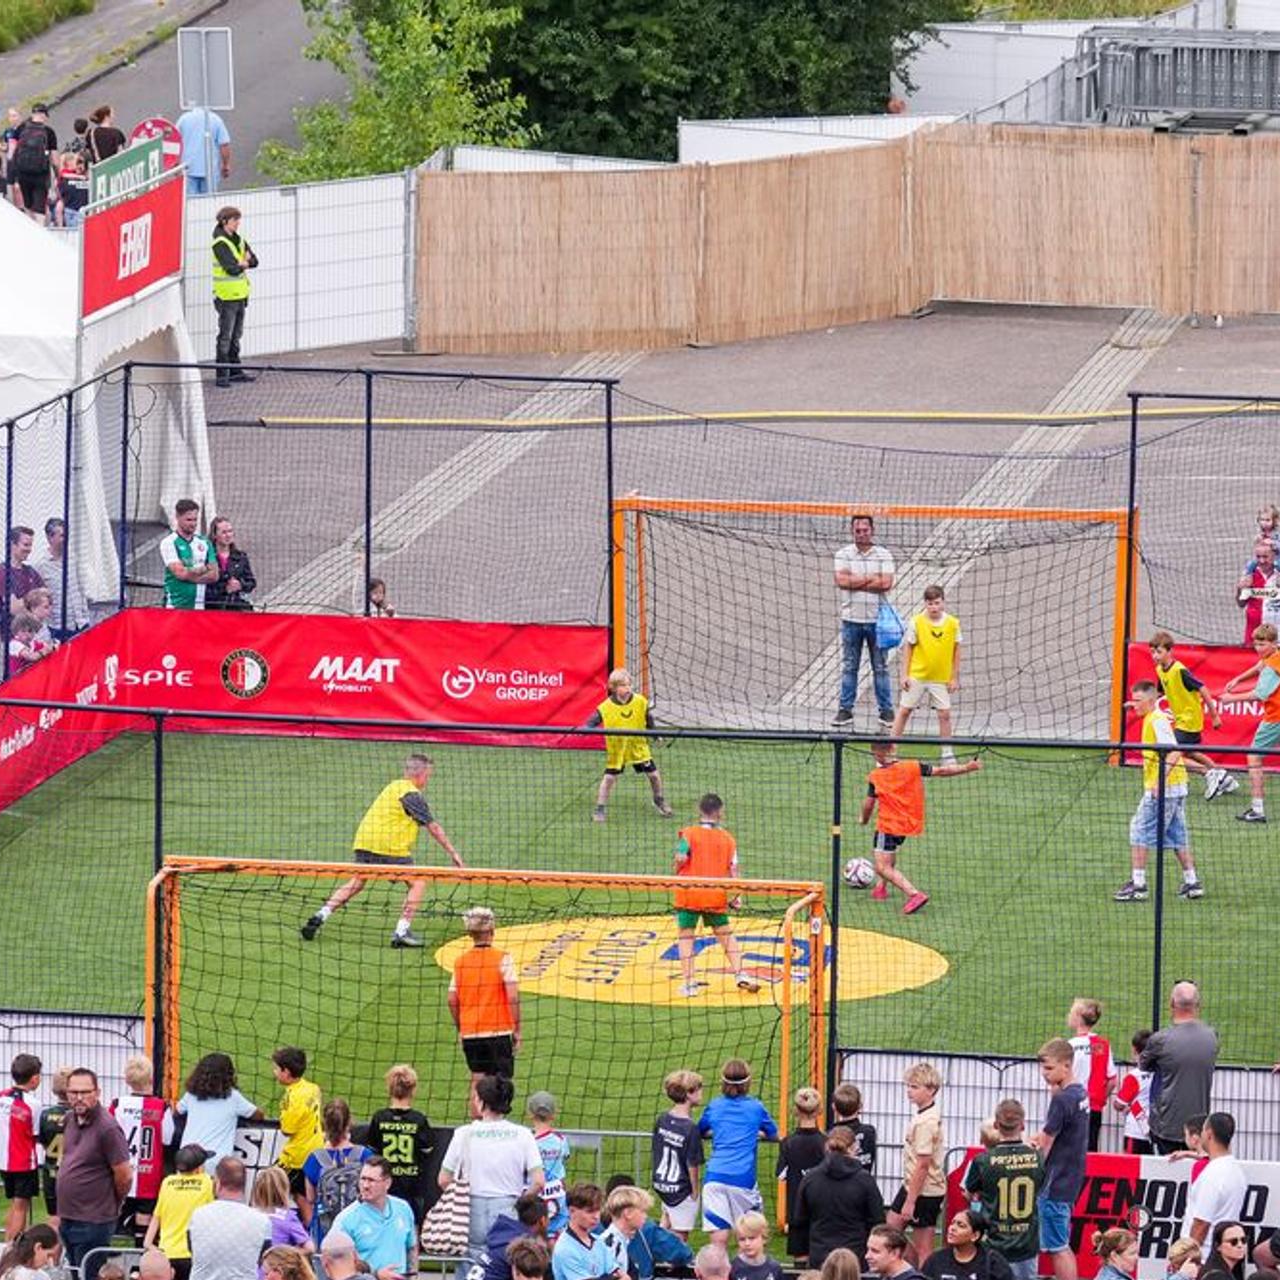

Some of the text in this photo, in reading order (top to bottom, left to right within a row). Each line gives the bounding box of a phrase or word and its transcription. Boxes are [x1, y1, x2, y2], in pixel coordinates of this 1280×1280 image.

[310, 657, 400, 686] MAAT
[475, 670, 564, 688] Van Ginkel
[496, 686, 549, 700] GROEP
[382, 1132, 414, 1164] 29
[998, 1176, 1035, 1219] 10
